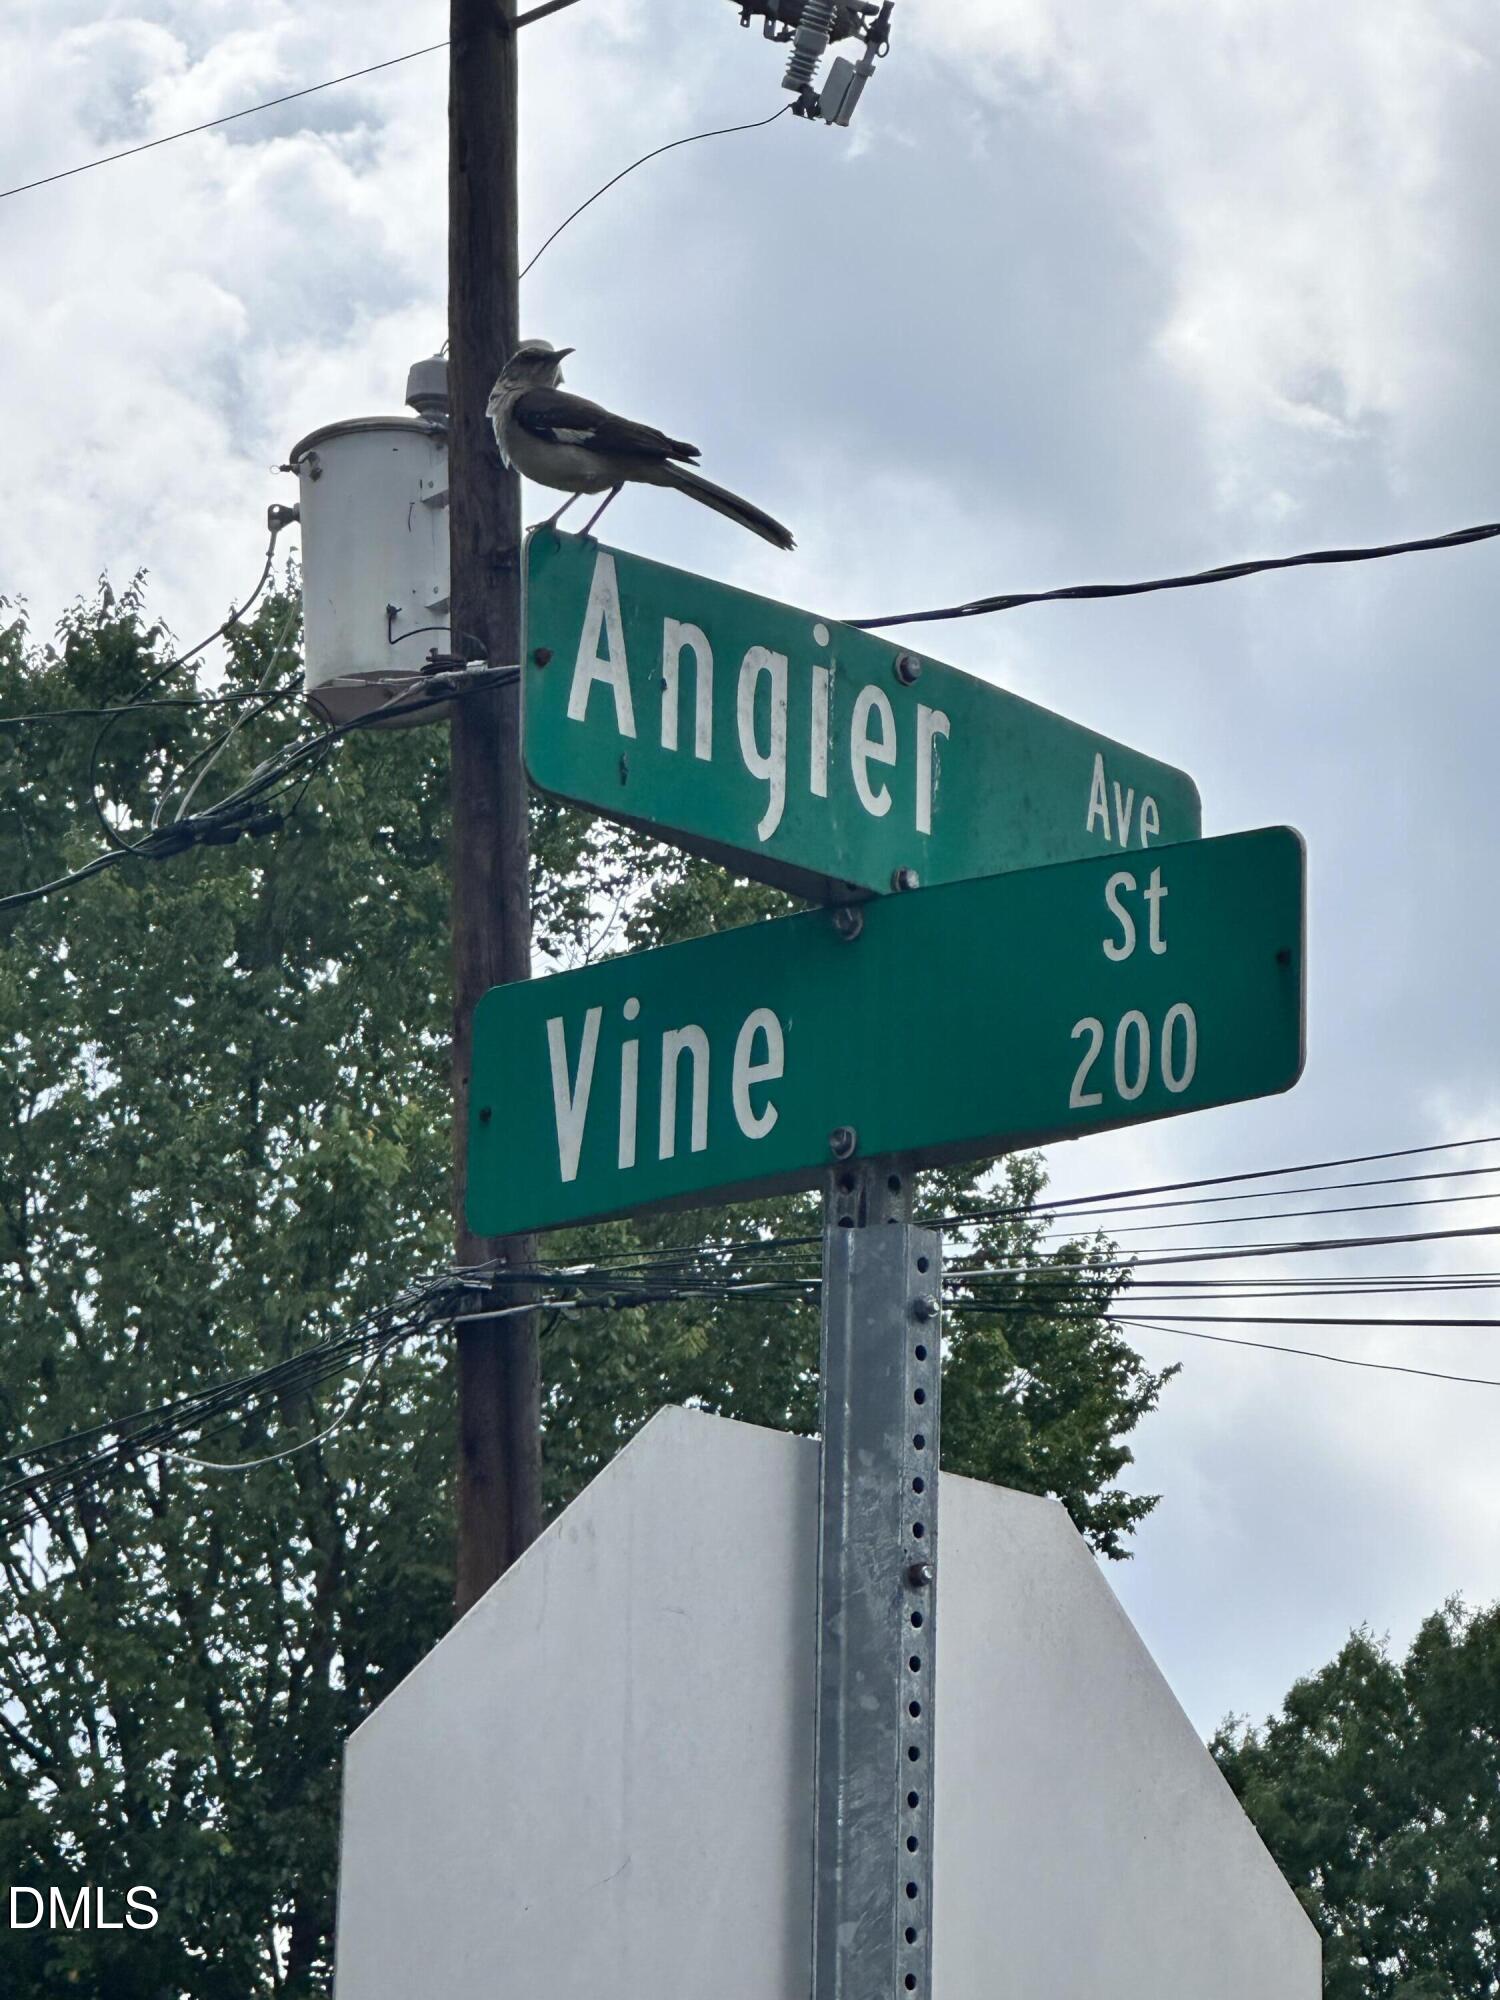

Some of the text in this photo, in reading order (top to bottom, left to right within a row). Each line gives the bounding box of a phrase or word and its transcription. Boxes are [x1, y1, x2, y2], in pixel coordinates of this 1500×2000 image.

[566, 552, 1160, 848] Angier Ave
[1102, 866, 1168, 961] St
[546, 997, 785, 1183] Vine
[1069, 1002, 1198, 1109] 200
